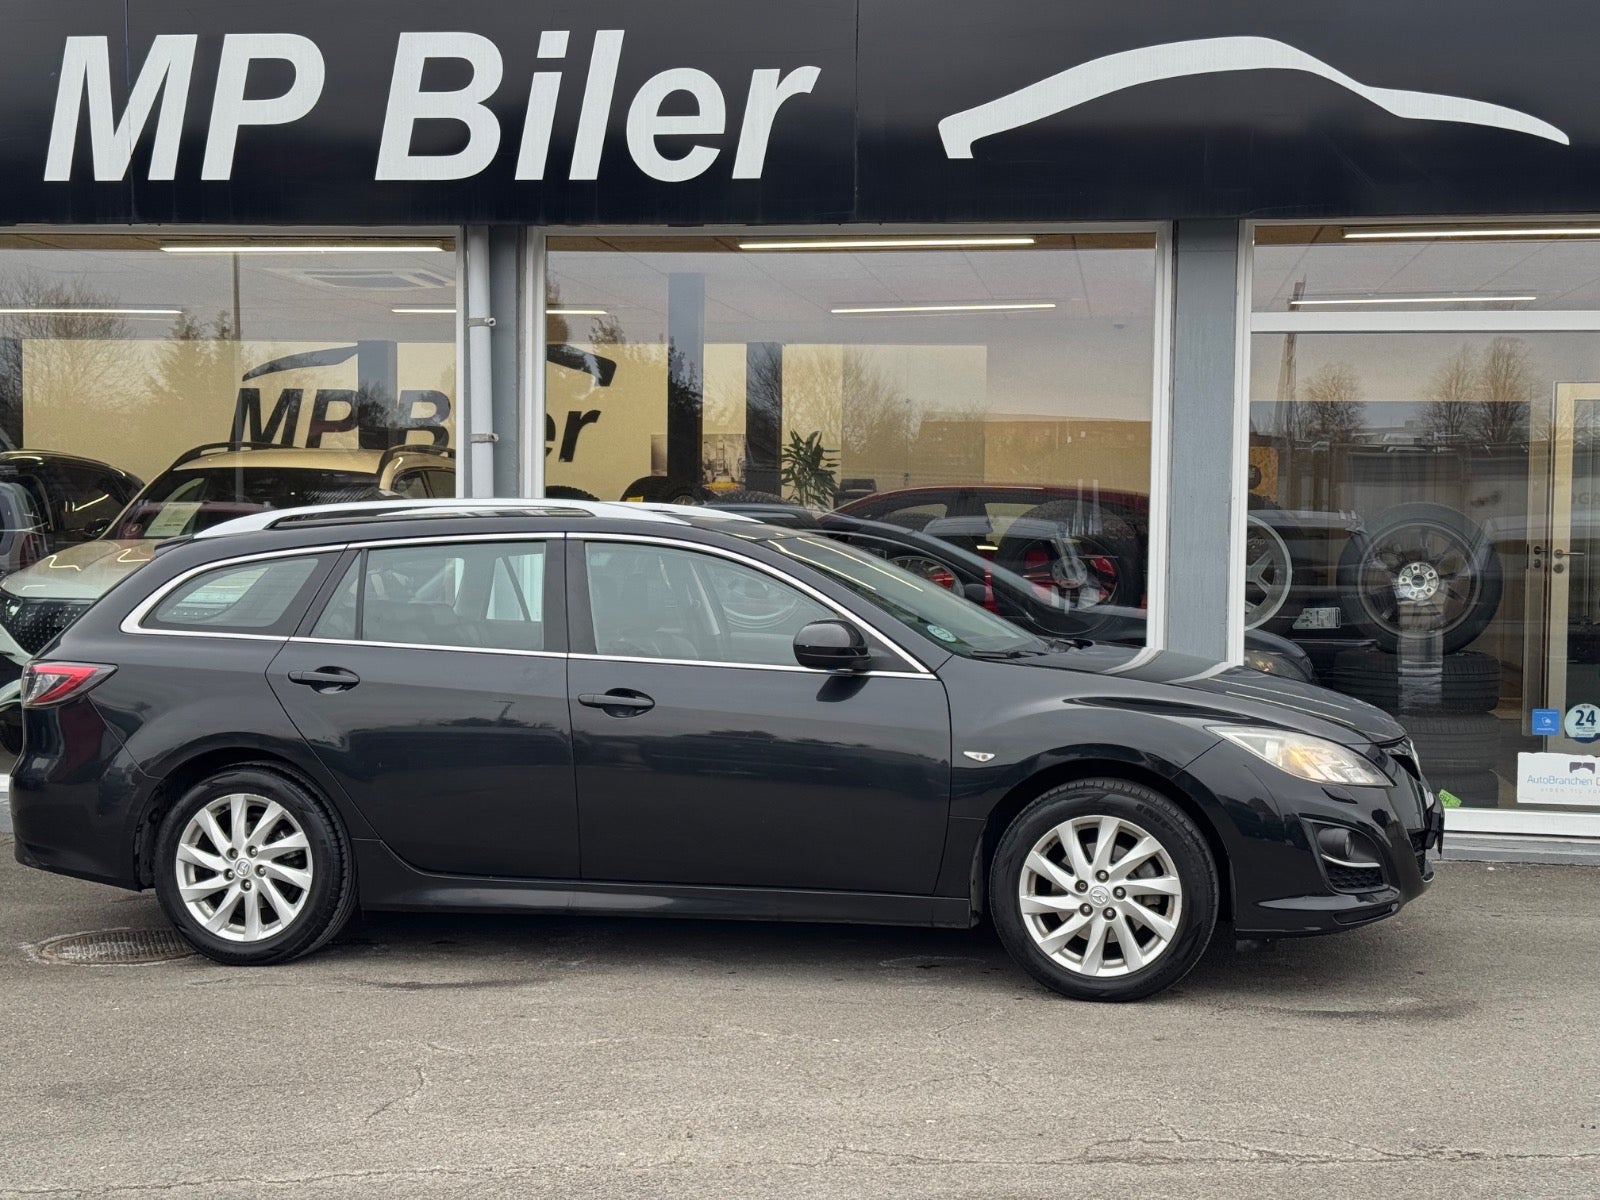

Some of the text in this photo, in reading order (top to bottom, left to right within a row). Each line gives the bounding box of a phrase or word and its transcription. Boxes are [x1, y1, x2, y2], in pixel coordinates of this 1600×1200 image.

[43, 29, 822, 183] MP Biler
[230, 387, 358, 448] MP
[1575, 709, 1597, 726] 24
[1527, 774, 1593, 786] AutoBranchen
